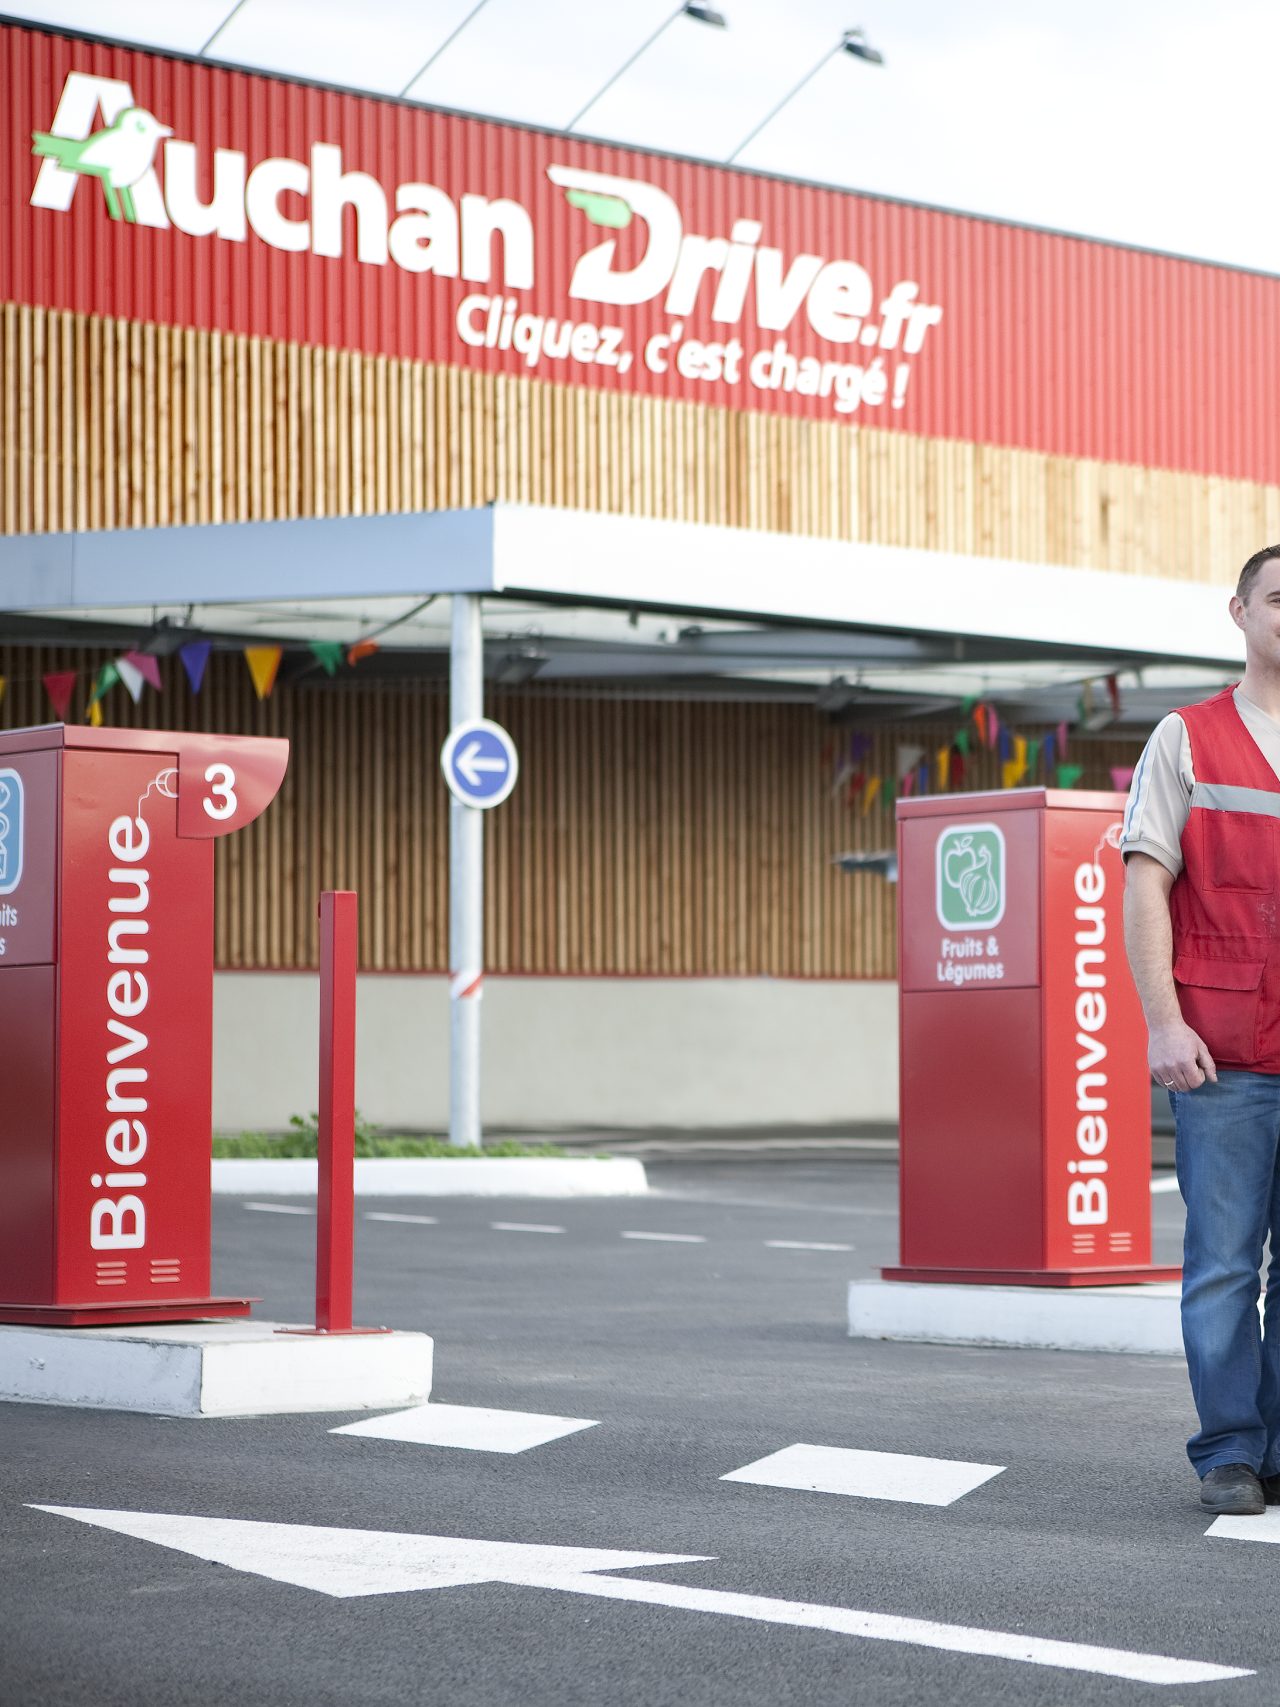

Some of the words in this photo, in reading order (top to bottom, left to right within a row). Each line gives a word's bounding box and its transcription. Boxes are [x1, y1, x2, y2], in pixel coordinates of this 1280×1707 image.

[31, 71, 534, 290] Auchan
[546, 164, 942, 354] Drive.fr
[456, 293, 633, 374] Cliquez,
[644, 322, 742, 385] c'est
[749, 340, 888, 414] chargé
[202, 763, 237, 820] 3
[936, 960, 1005, 987] Légumes
[941, 937, 983, 959] Fruits
[986, 935, 999, 957] &
[90, 814, 150, 1250] Bienvenue
[1067, 861, 1108, 1226] Bienvenue
